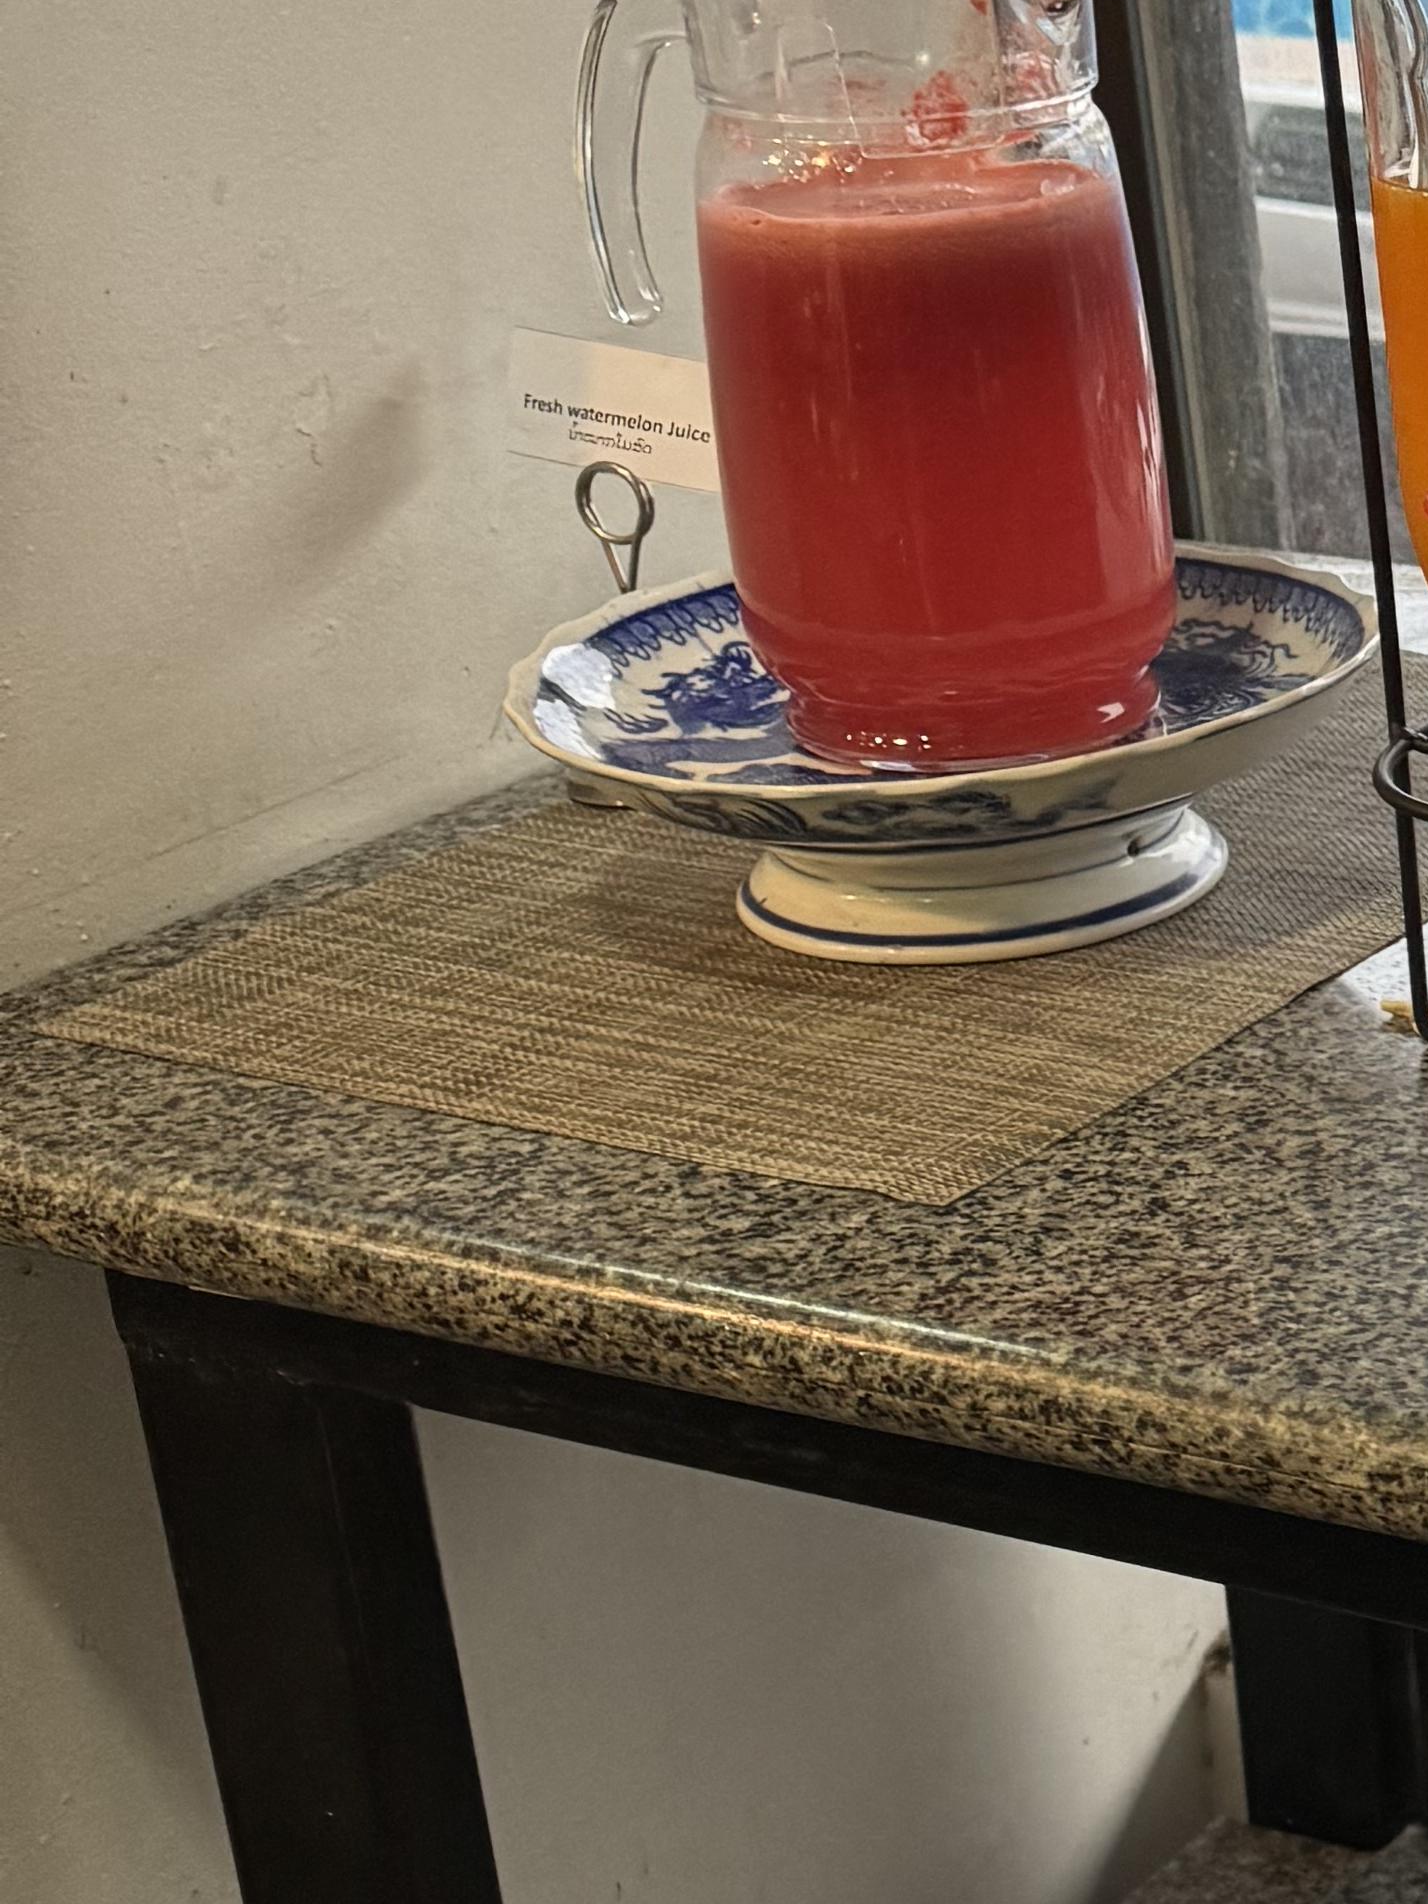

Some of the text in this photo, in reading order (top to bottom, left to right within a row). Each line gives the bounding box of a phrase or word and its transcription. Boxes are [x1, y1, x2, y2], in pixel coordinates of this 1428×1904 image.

[523, 393, 712, 444] Fresh watermelon Juice
